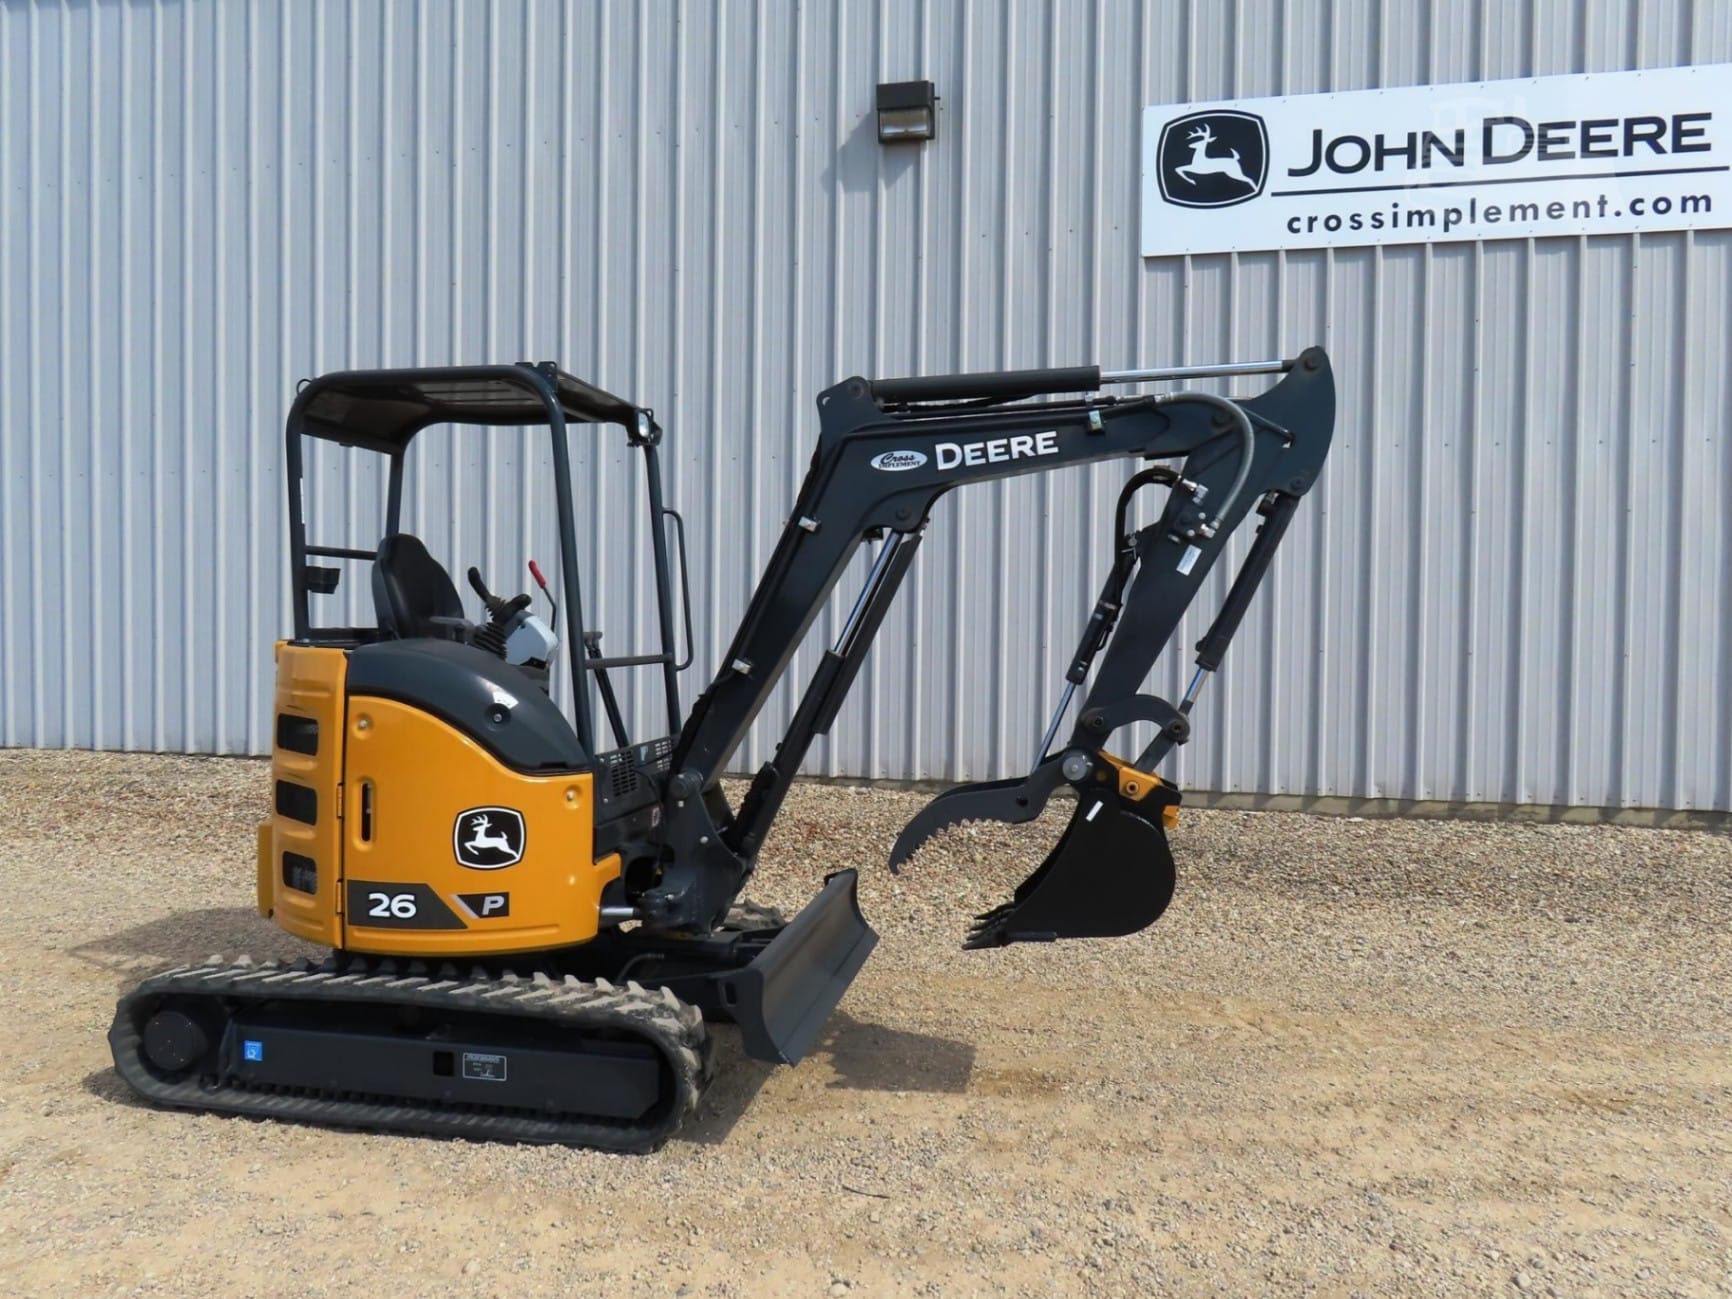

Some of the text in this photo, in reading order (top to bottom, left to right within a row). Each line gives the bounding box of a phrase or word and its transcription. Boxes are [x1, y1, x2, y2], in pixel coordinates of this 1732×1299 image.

[1287, 111, 1713, 176] JOHN DEERE
[1287, 193, 1713, 233] crossimplement.com
[936, 431, 1058, 470] DEERE
[368, 893, 504, 918] 26 P
